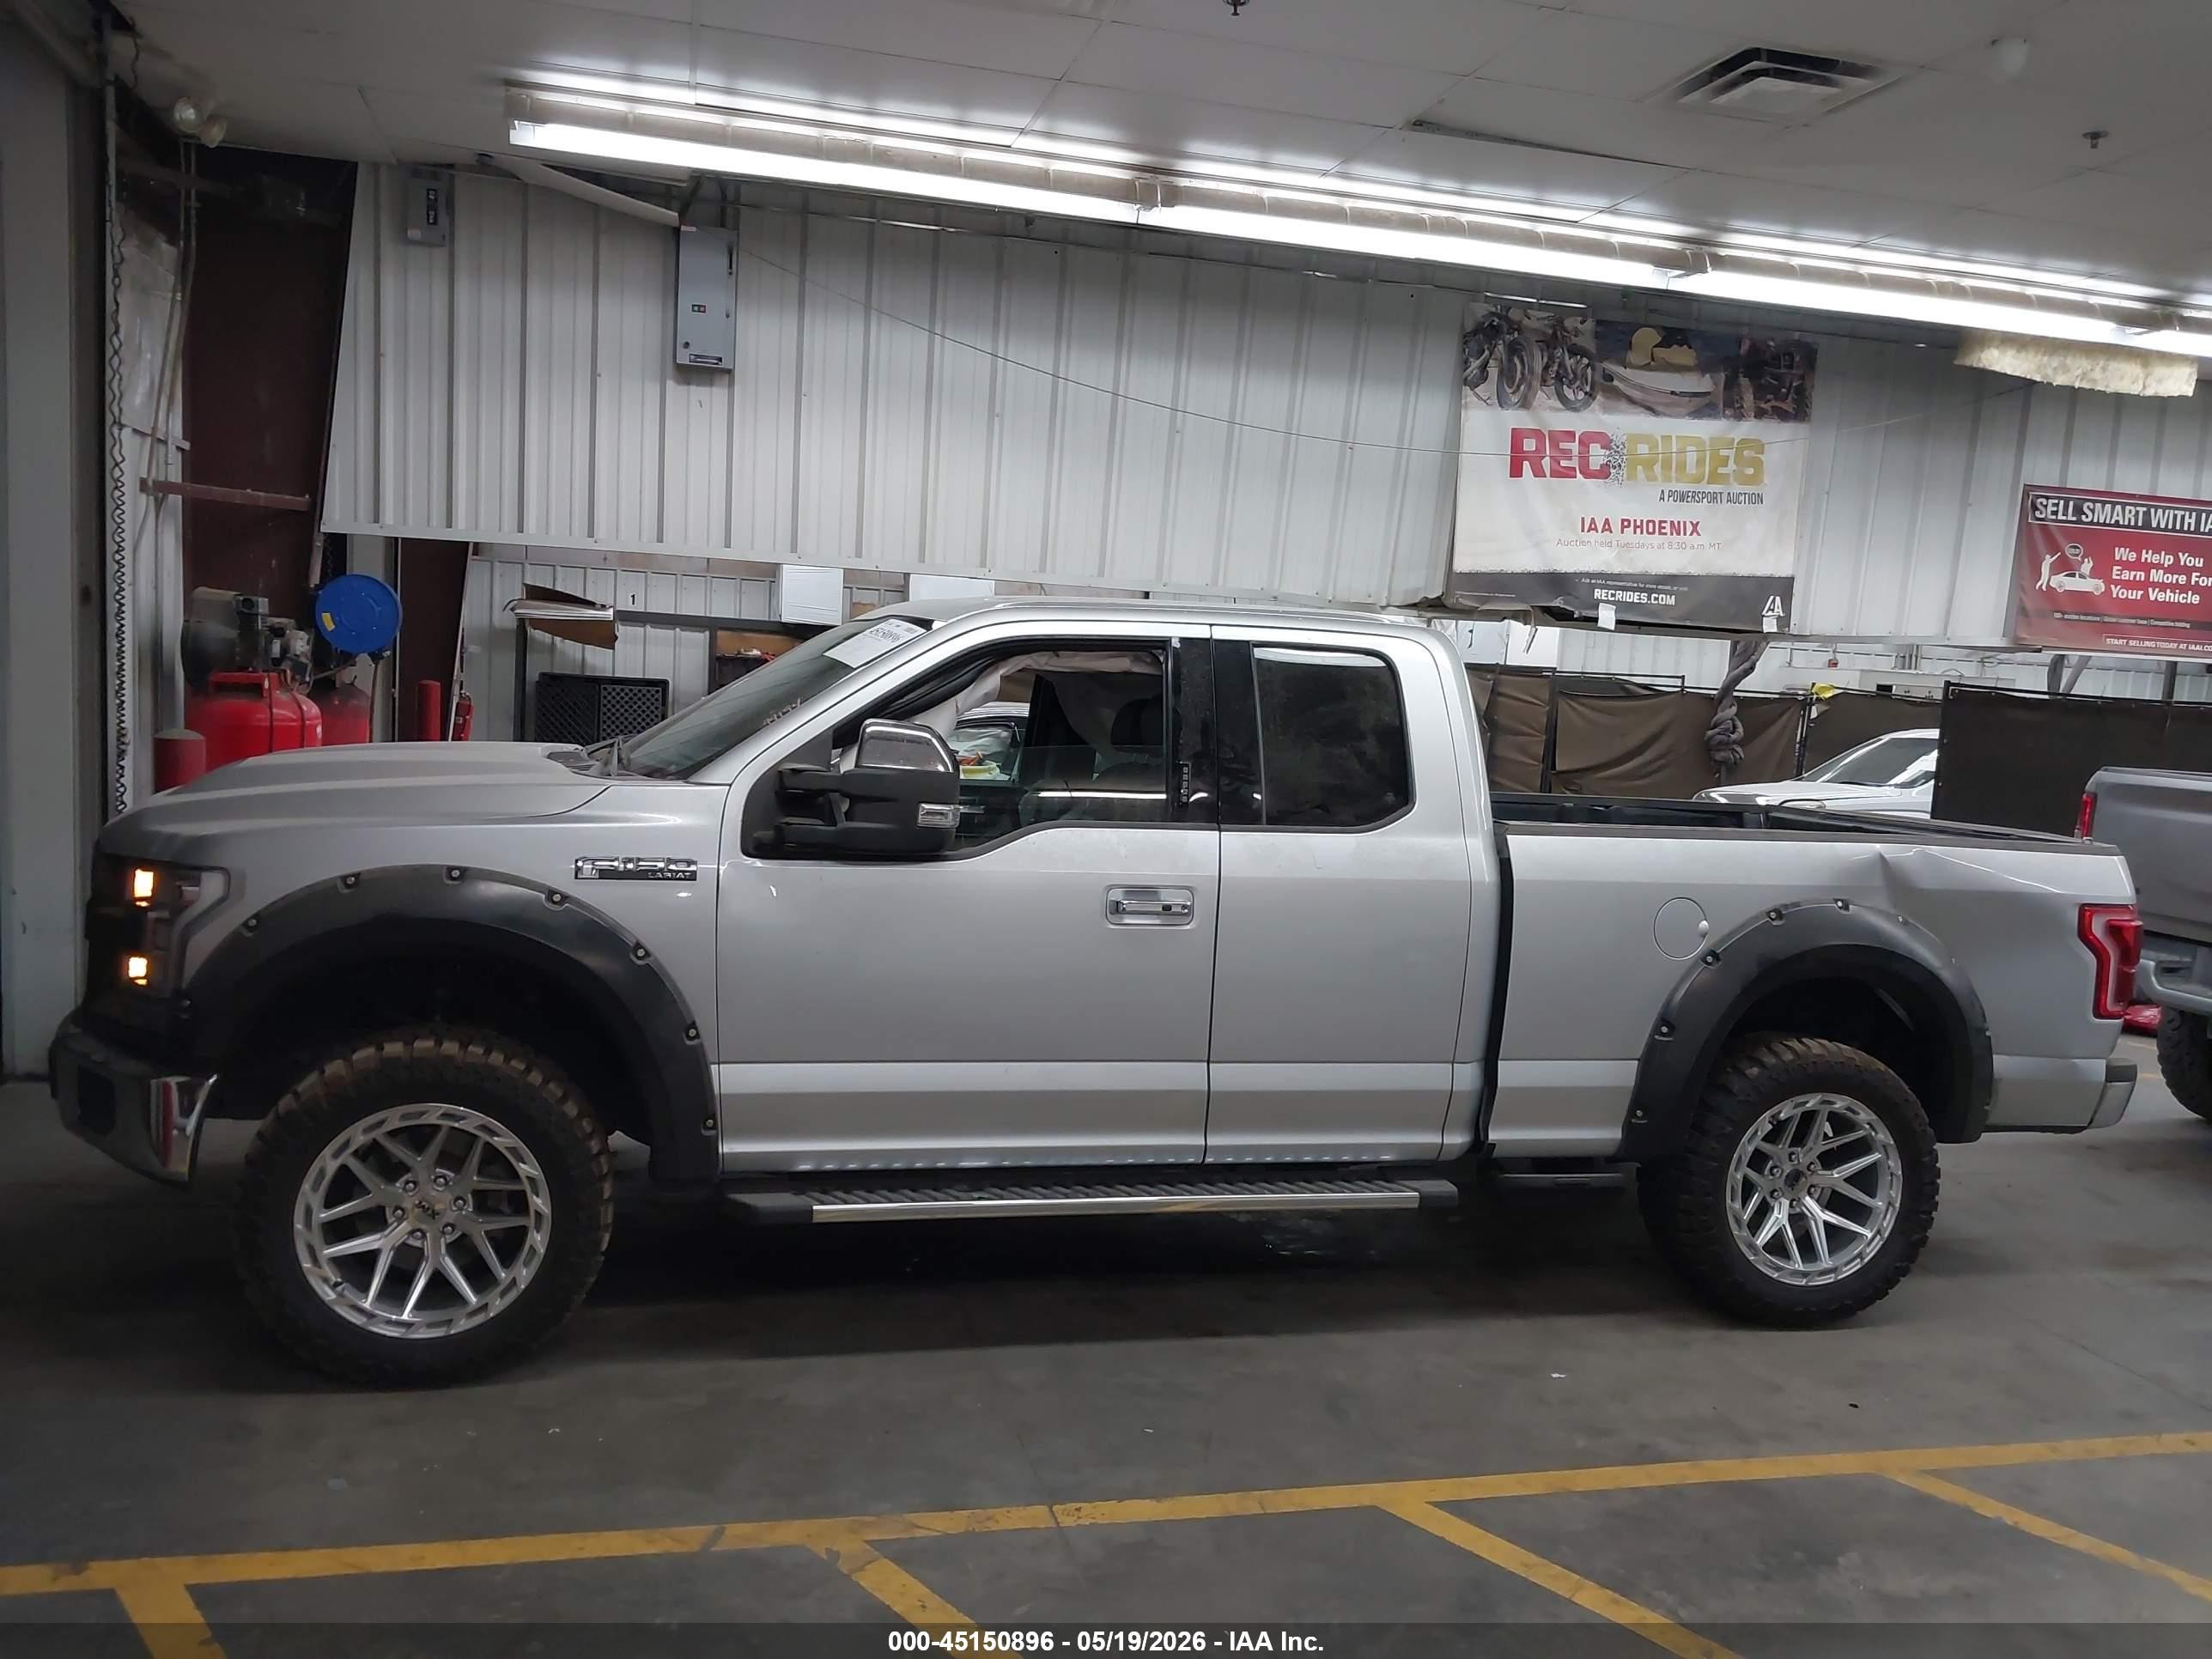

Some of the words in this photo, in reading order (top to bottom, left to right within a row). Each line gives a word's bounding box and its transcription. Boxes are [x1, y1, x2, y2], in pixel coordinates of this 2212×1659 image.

[1509, 427, 1613, 480] REC
[1626, 433, 1765, 487] RIDES
[1659, 489, 1665, 502] A
[1667, 490, 1723, 504] POWERSPORT
[1726, 492, 1764, 505] AUCTION
[2034, 497, 2077, 521] SELL
[2081, 501, 2147, 526] SMART
[2150, 507, 2197, 532] WITH
[1580, 516, 1613, 534] IAA
[1620, 518, 1702, 537] PHOENIX
[1556, 538, 1592, 547] Auction
[1595, 538, 1613, 548] held
[1614, 539, 1655, 550] Tuesdays
[1709, 542, 1722, 550] MT
[2114, 546, 2137, 562] We
[2141, 549, 2174, 568] Help
[2178, 552, 2204, 568] You
[2112, 565, 2145, 581] Earn
[2149, 568, 2187, 585] More
[2191, 572, 2212, 587] For
[630, 593, 635, 605] 1
[1594, 588, 1675, 605] RECRIDES.COM
[2110, 584, 2144, 600] Your
[2148, 587, 2200, 605] Vehicle
[647, 870, 691, 879] LARIAT
